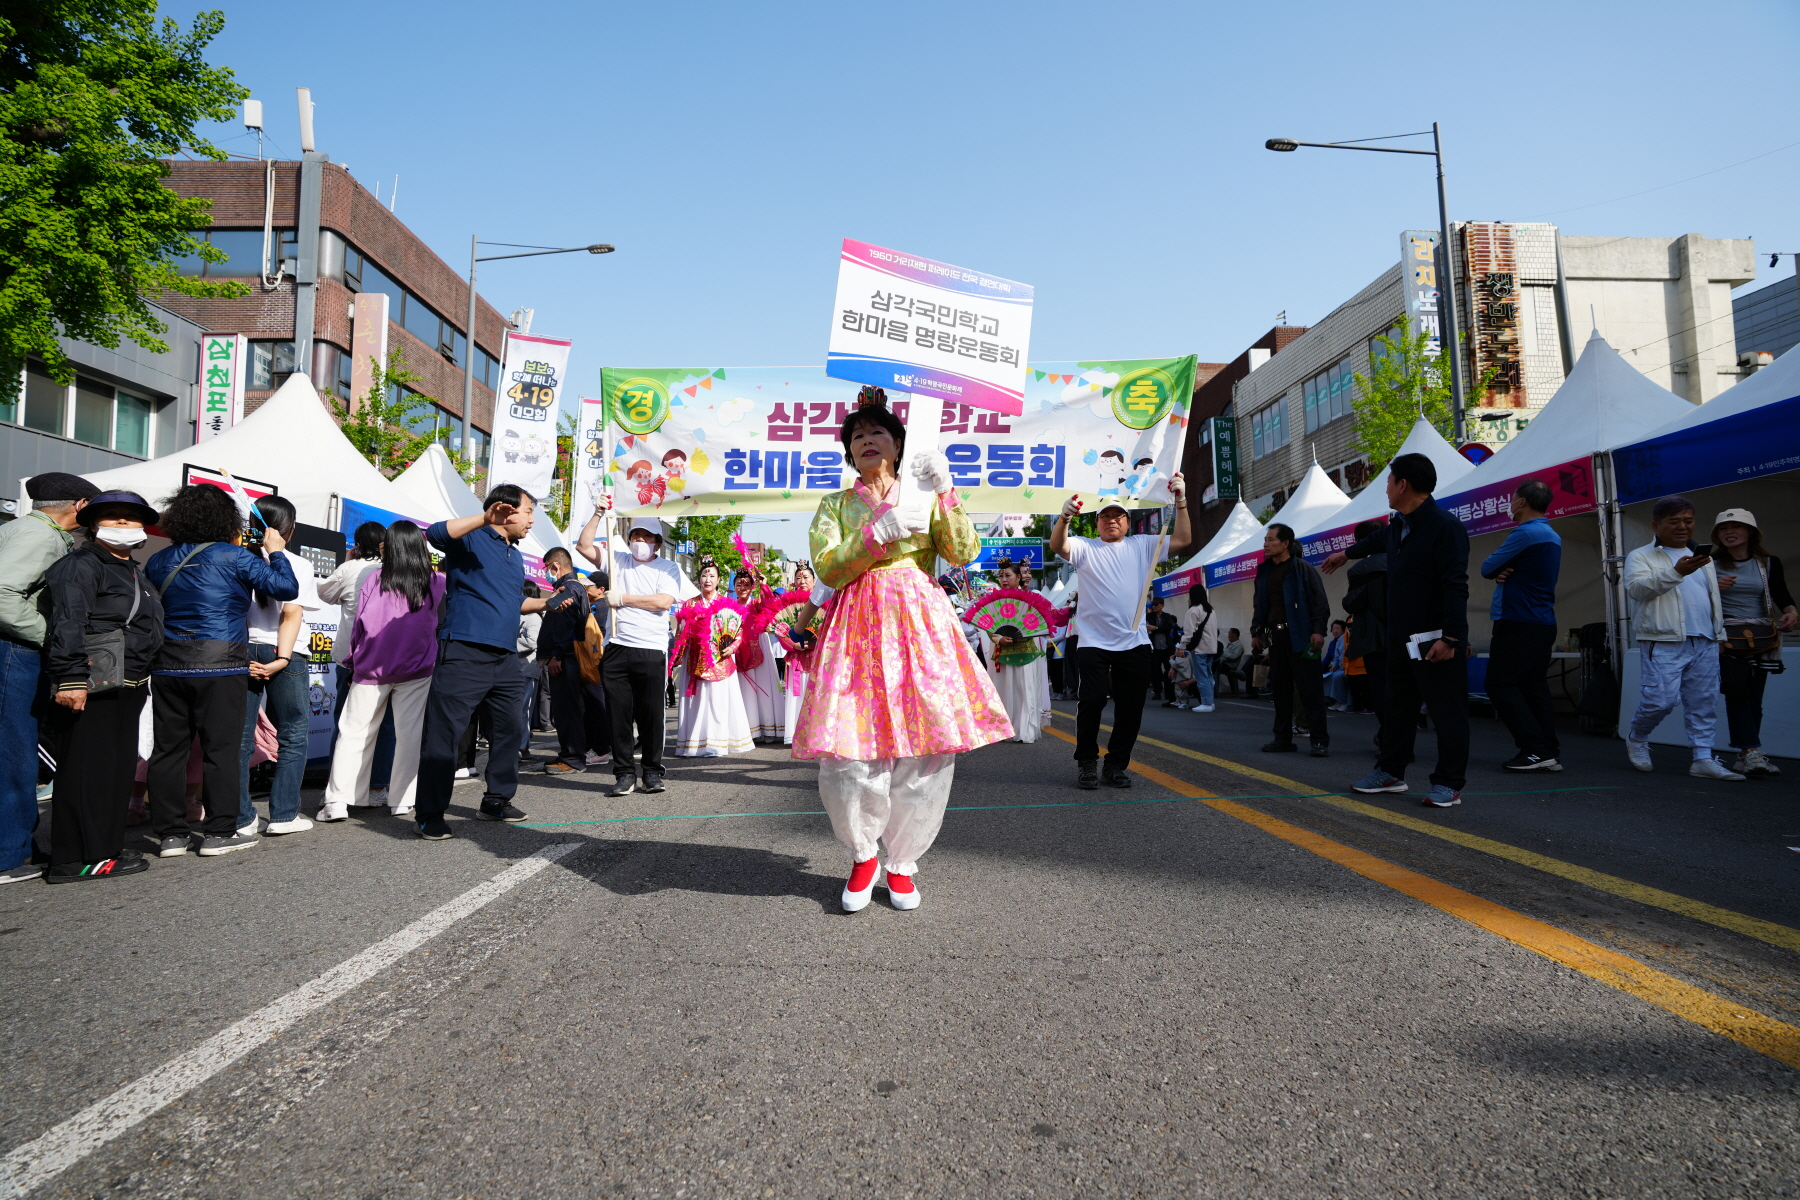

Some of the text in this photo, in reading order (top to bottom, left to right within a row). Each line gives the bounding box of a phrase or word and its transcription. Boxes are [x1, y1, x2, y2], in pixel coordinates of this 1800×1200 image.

[869, 249, 1011, 293] 1960 거리재현 퍼레이드 전국 경연대회
[871, 290, 1000, 337] 삼각국민학교
[842, 309, 1020, 368] 한마음 명랑운동회
[206, 338, 235, 413] 삼천포
[512, 371, 557, 388] 함께 떠나는
[524, 359, 555, 376] 보보와
[507, 382, 554, 408] 4·19
[625, 389, 655, 422] 경
[1126, 379, 1160, 416] 축
[509, 404, 547, 421] 대모험
[1216, 420, 1233, 428] The
[723, 448, 844, 491] 한마음
[1219, 430, 1233, 487] 예쁨헤어
[990, 548, 1012, 557] 도봉로
[1214, 558, 1258, 579] 합동상황실 소방본부
